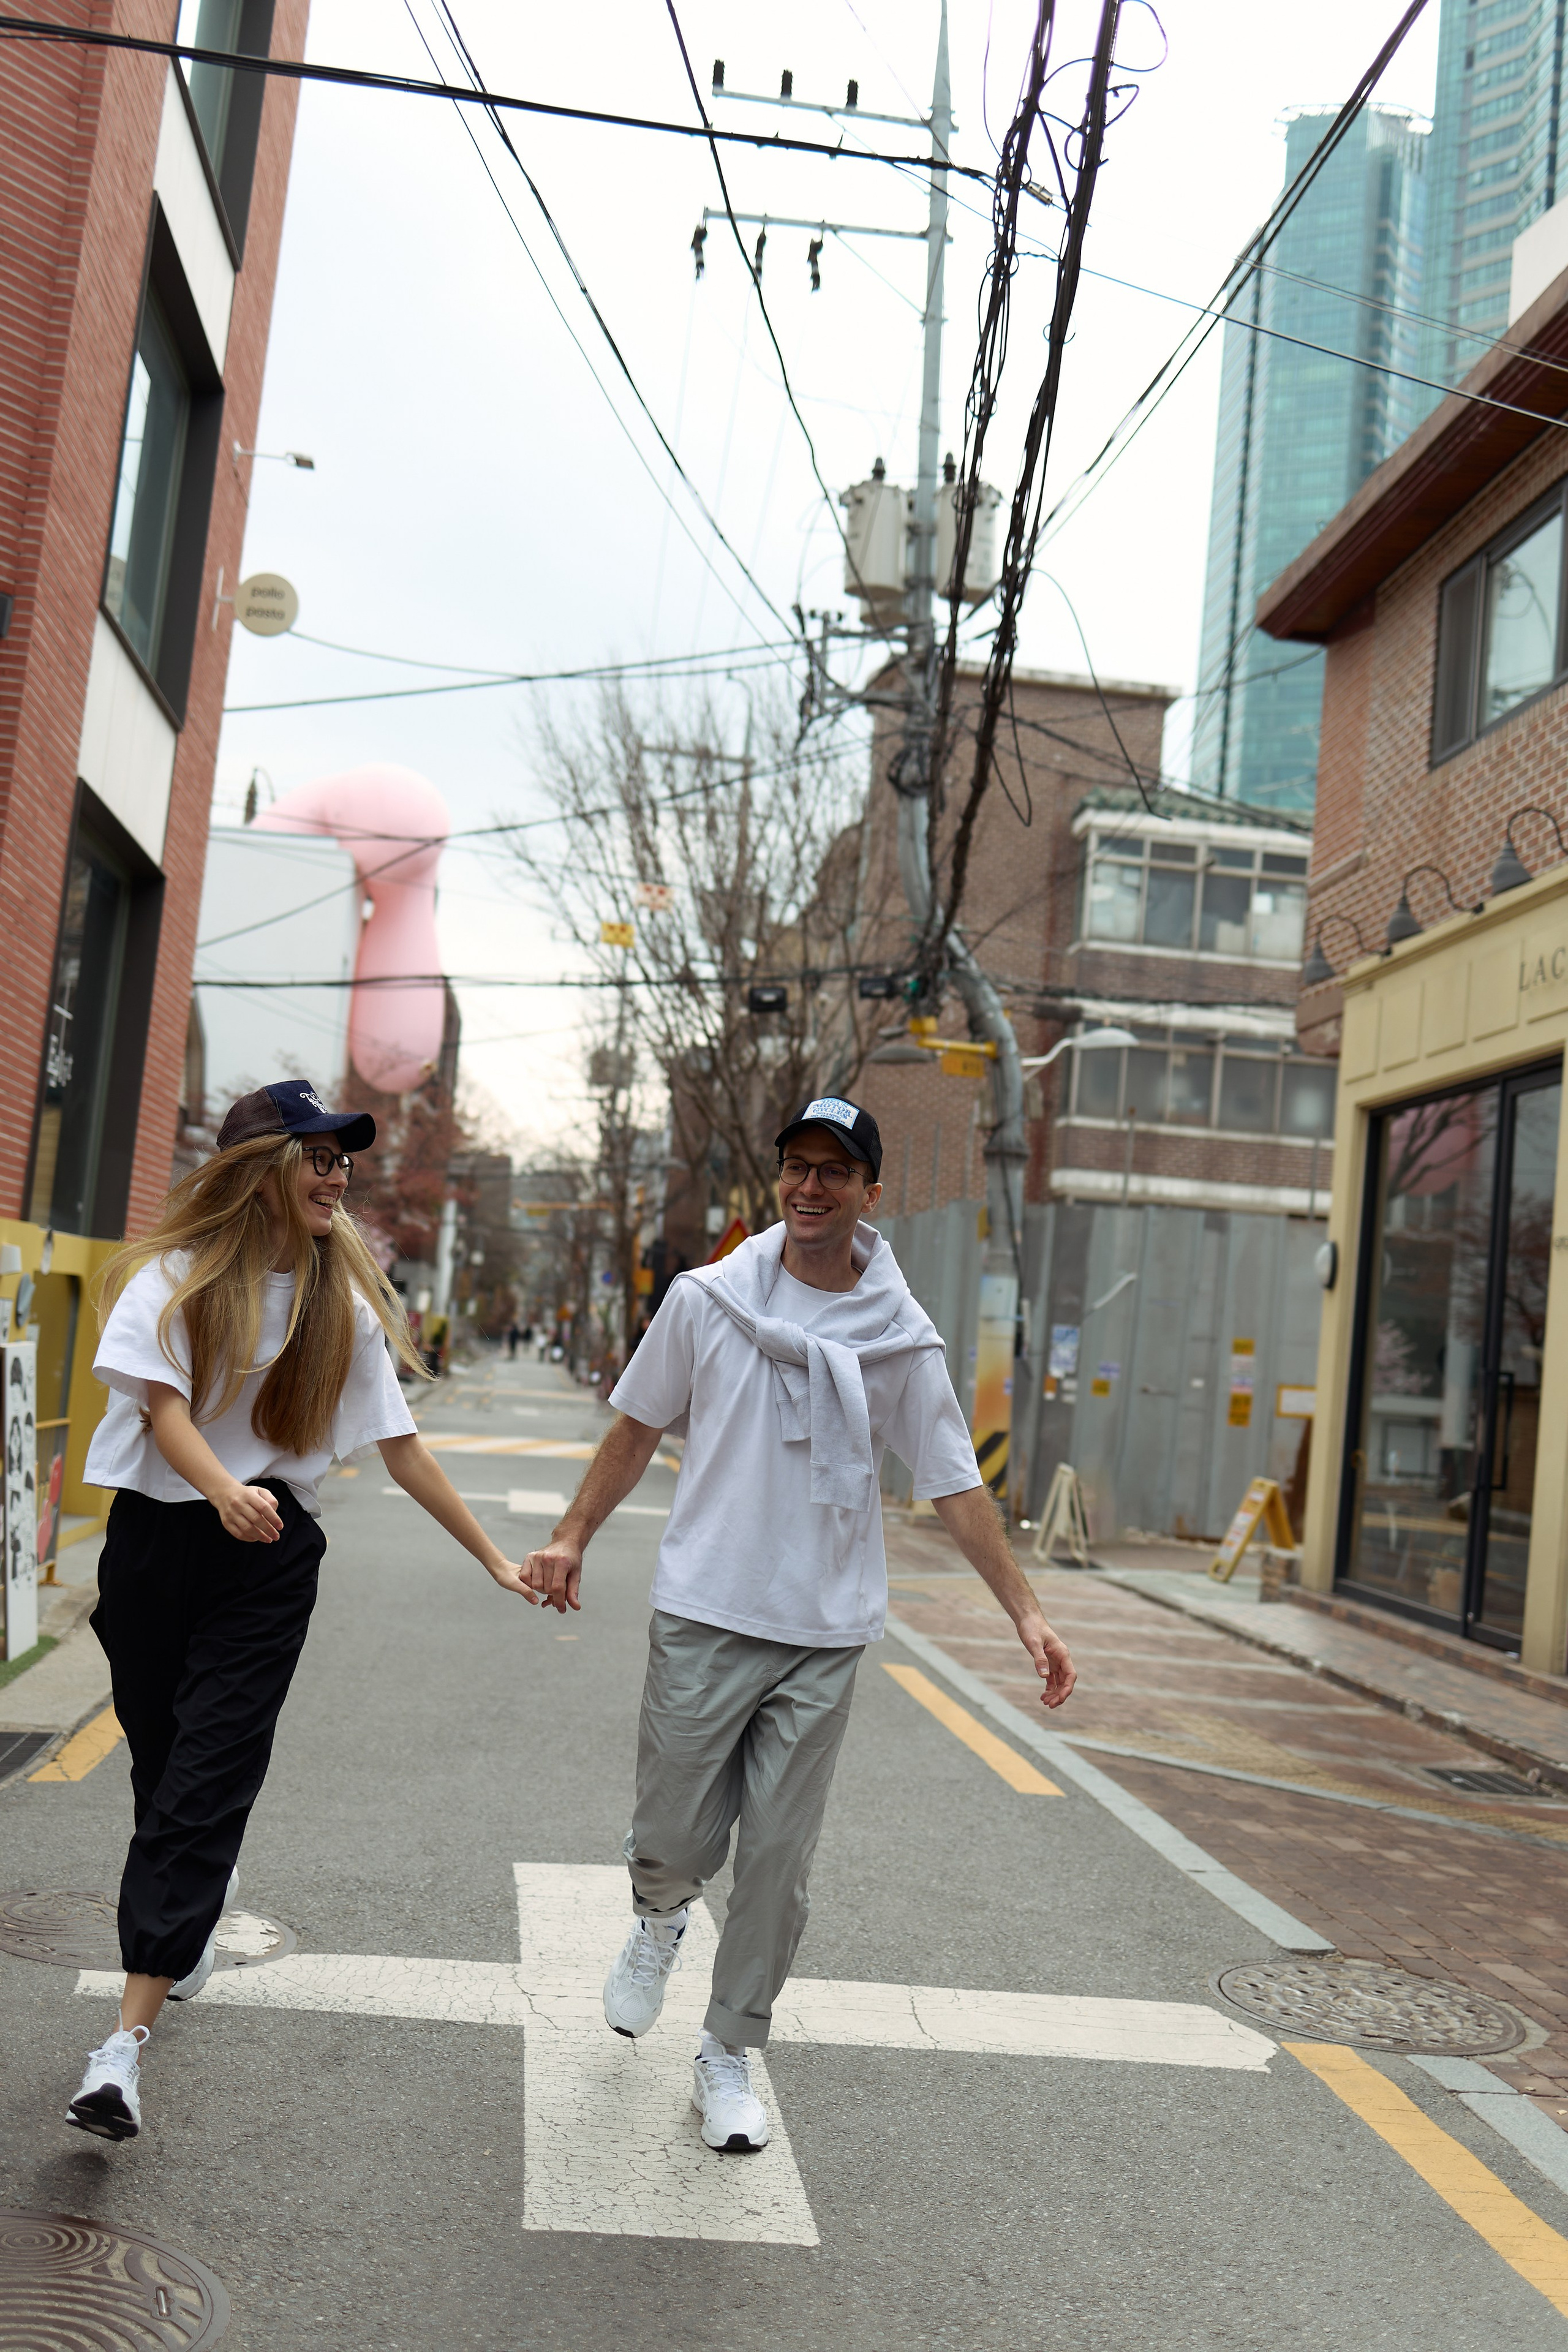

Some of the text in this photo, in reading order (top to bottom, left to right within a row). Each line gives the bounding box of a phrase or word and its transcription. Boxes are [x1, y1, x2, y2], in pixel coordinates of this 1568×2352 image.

[1519, 946, 1566, 992] LAC
[812, 1103, 851, 1118] MOTOR
[812, 1108, 847, 1120] CYCLES
